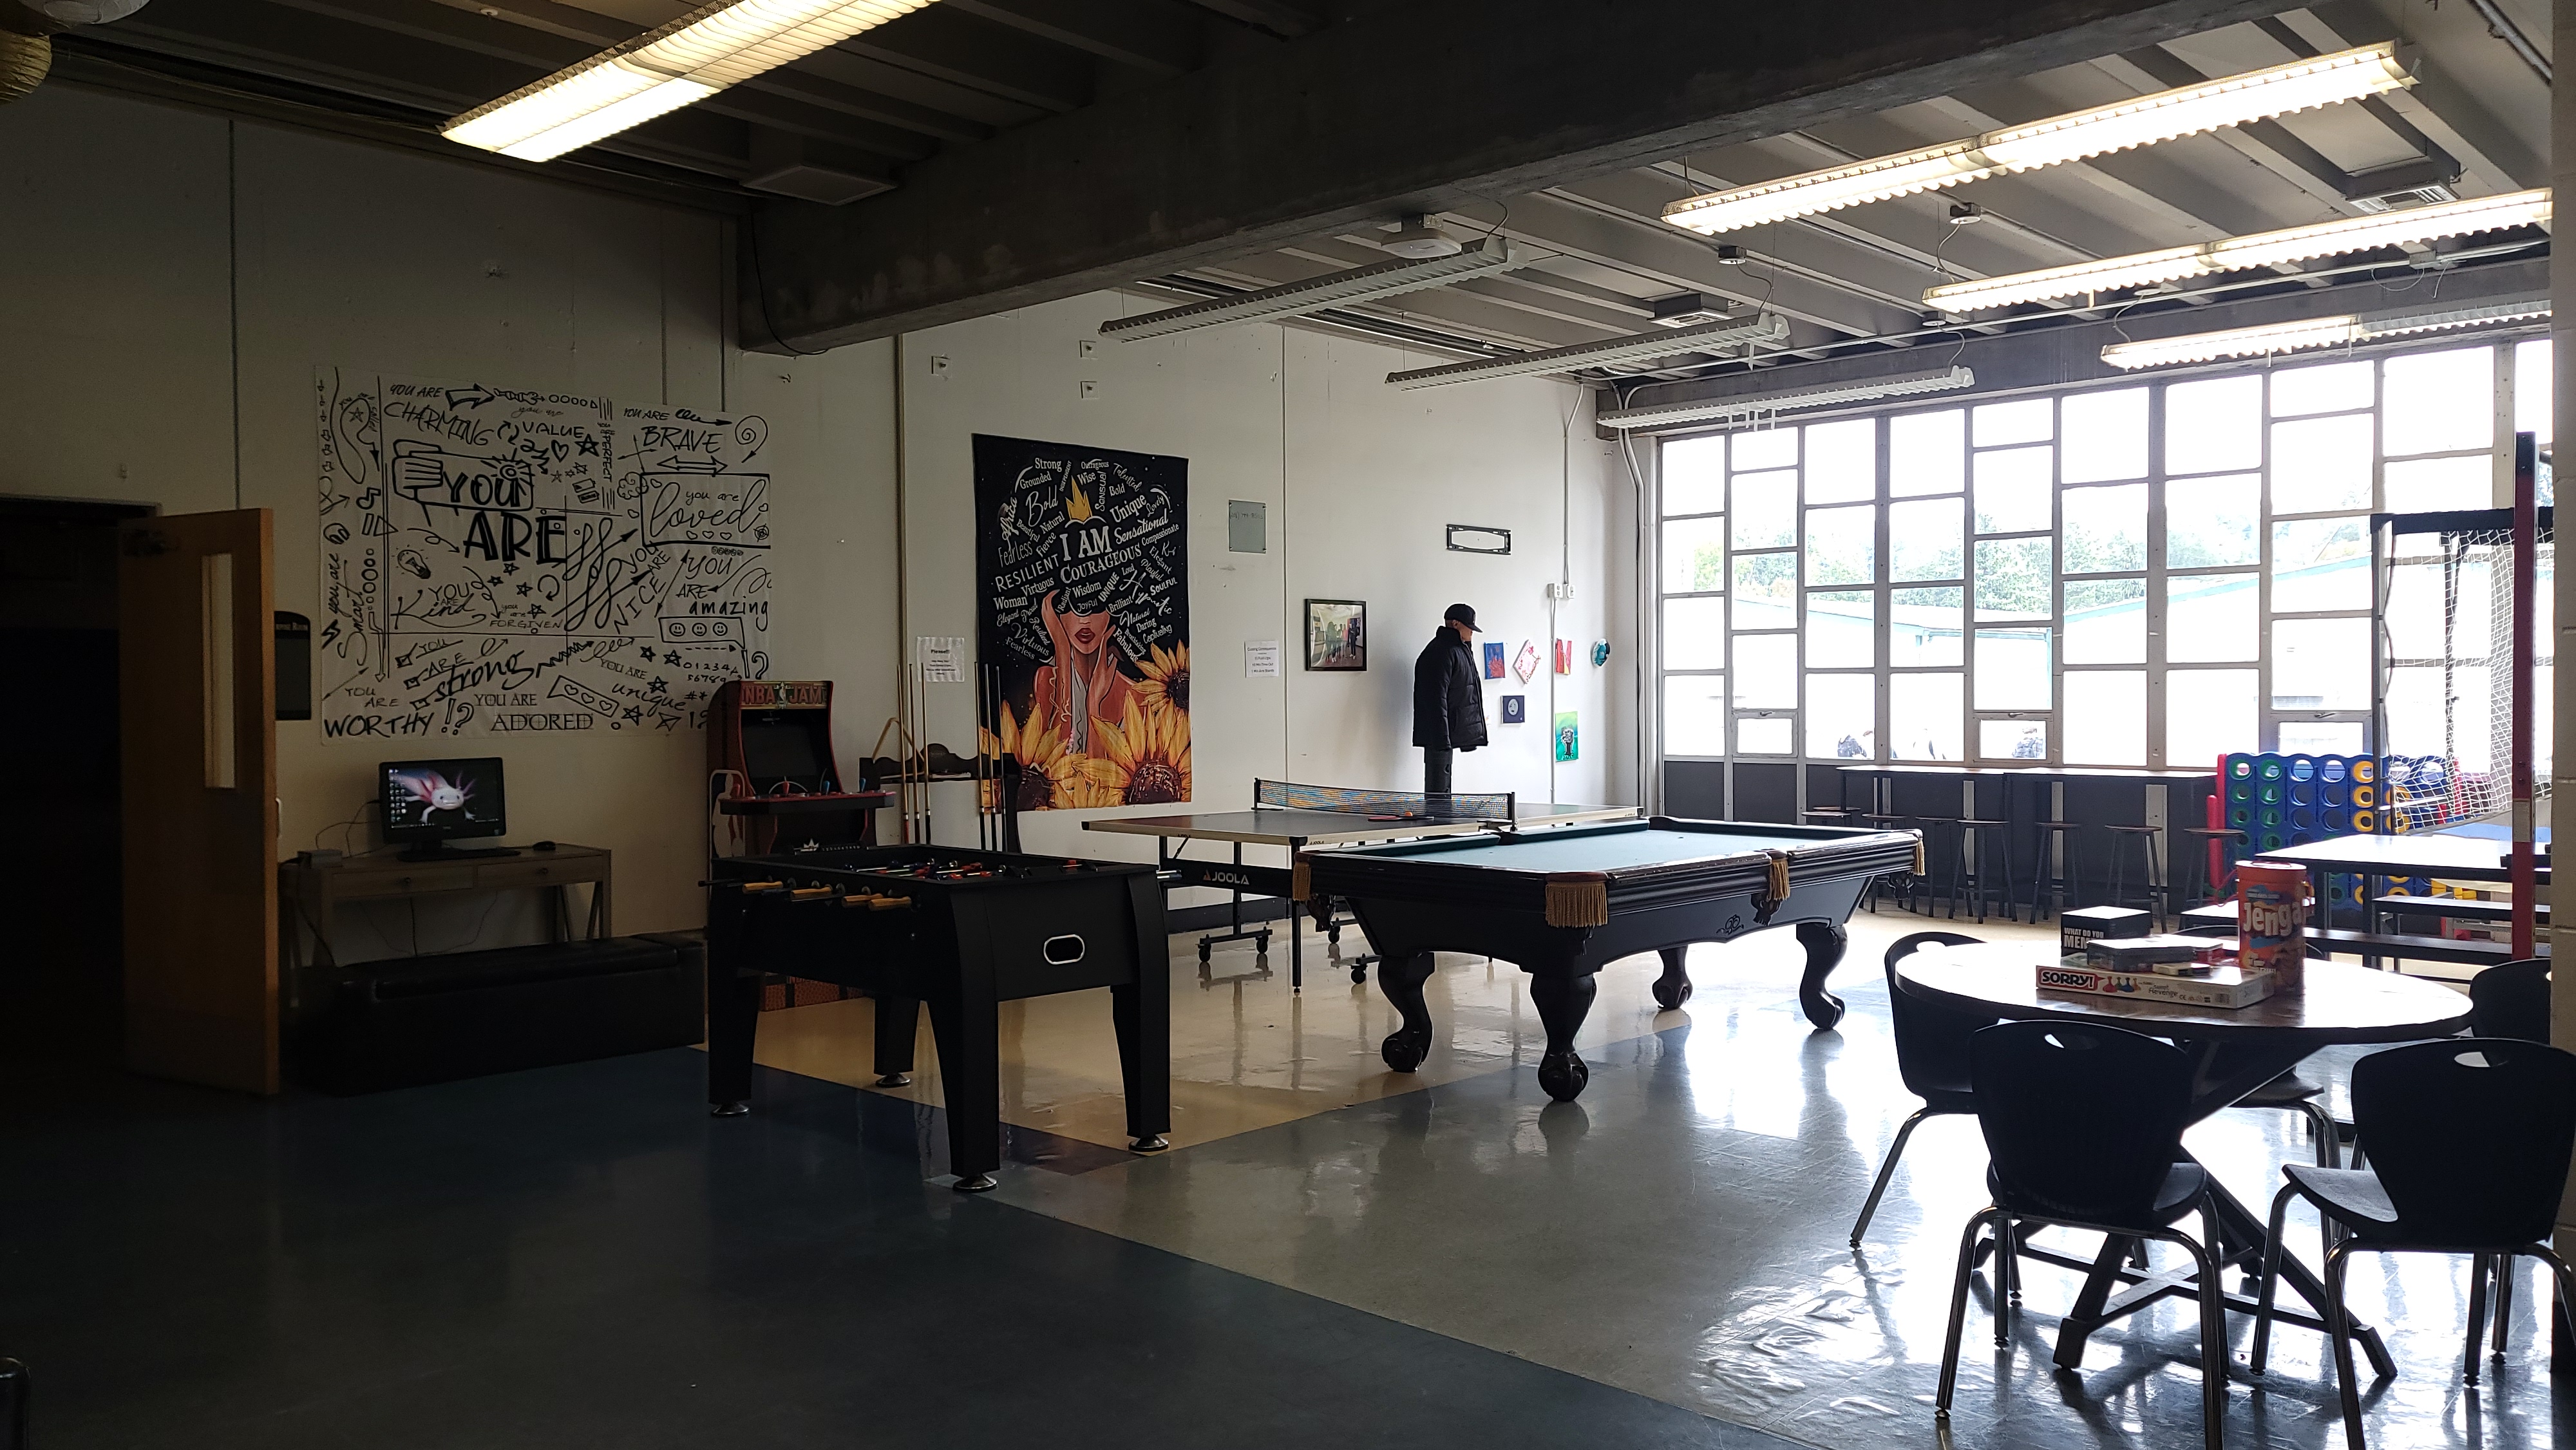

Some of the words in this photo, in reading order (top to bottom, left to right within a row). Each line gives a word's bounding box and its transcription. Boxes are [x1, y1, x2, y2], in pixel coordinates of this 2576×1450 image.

[390, 384, 416, 395] YOU
[418, 386, 444, 398] ARE
[384, 402, 493, 445] CHARMING
[623, 408, 642, 417] YOU
[644, 411, 670, 420] ARE
[522, 421, 585, 438] VALUE
[641, 426, 723, 453] BRAVE
[1034, 458, 1063, 472] Strong
[443, 471, 520, 507] YOU
[1019, 470, 1052, 489] Grounded
[1077, 471, 1097, 486] Wise
[686, 490, 710, 505] you
[717, 493, 739, 502] are
[1108, 482, 1126, 497] Bold
[650, 479, 766, 537] loved
[1025, 484, 1058, 527] Bold
[1110, 494, 1147, 523] Unique
[1039, 511, 1065, 535] Natural
[1113, 507, 1169, 545] Sensational
[463, 511, 567, 565] ARE
[1036, 532, 1057, 558] Fierce
[1059, 533, 1072, 561] I
[1079, 525, 1113, 559] AM
[685, 556, 732, 579] YOU
[995, 553, 1060, 593] RESILIENT
[1121, 562, 1135, 576] Loud
[428, 582, 469, 601] YOU
[676, 583, 710, 599] ARE
[1021, 577, 1055, 598] Virtuous
[1072, 581, 1102, 599] Wisdom
[1098, 571, 1120, 603] UNIQUE
[391, 590, 478, 629] Kind
[614, 576, 666, 634] NICE
[993, 596, 1028, 610] Woman
[1108, 594, 1134, 613] Brilliant
[490, 619, 563, 628] FORGIVEN
[689, 596, 768, 632] amazing
[1136, 617, 1157, 633] Daring
[1005, 636, 1036, 660] Fearless
[1010, 622, 1050, 657] Virtuous
[1113, 627, 1139, 663] Fabulous
[429, 652, 466, 677] ARE
[600, 657, 624, 673] YOU
[625, 666, 648, 679] ARE
[345, 687, 376, 696] YOU
[475, 694, 506, 706] YOU
[510, 694, 537, 706] ARE
[612, 683, 686, 717] unique
[745, 686, 775, 704] NBA
[790, 686, 822, 704] JAM
[365, 697, 399, 708] ARE
[324, 713, 435, 738] WORTHY
[491, 713, 594, 731] ADORED
[1211, 871, 1250, 885] JOOLA
[2243, 901, 2302, 937] Jenga
[2064, 927, 2081, 936] WHAT
[2082, 929, 2091, 937] DO
[2092, 930, 2105, 939] YOU
[2042, 971, 2093, 988] SORRY!
